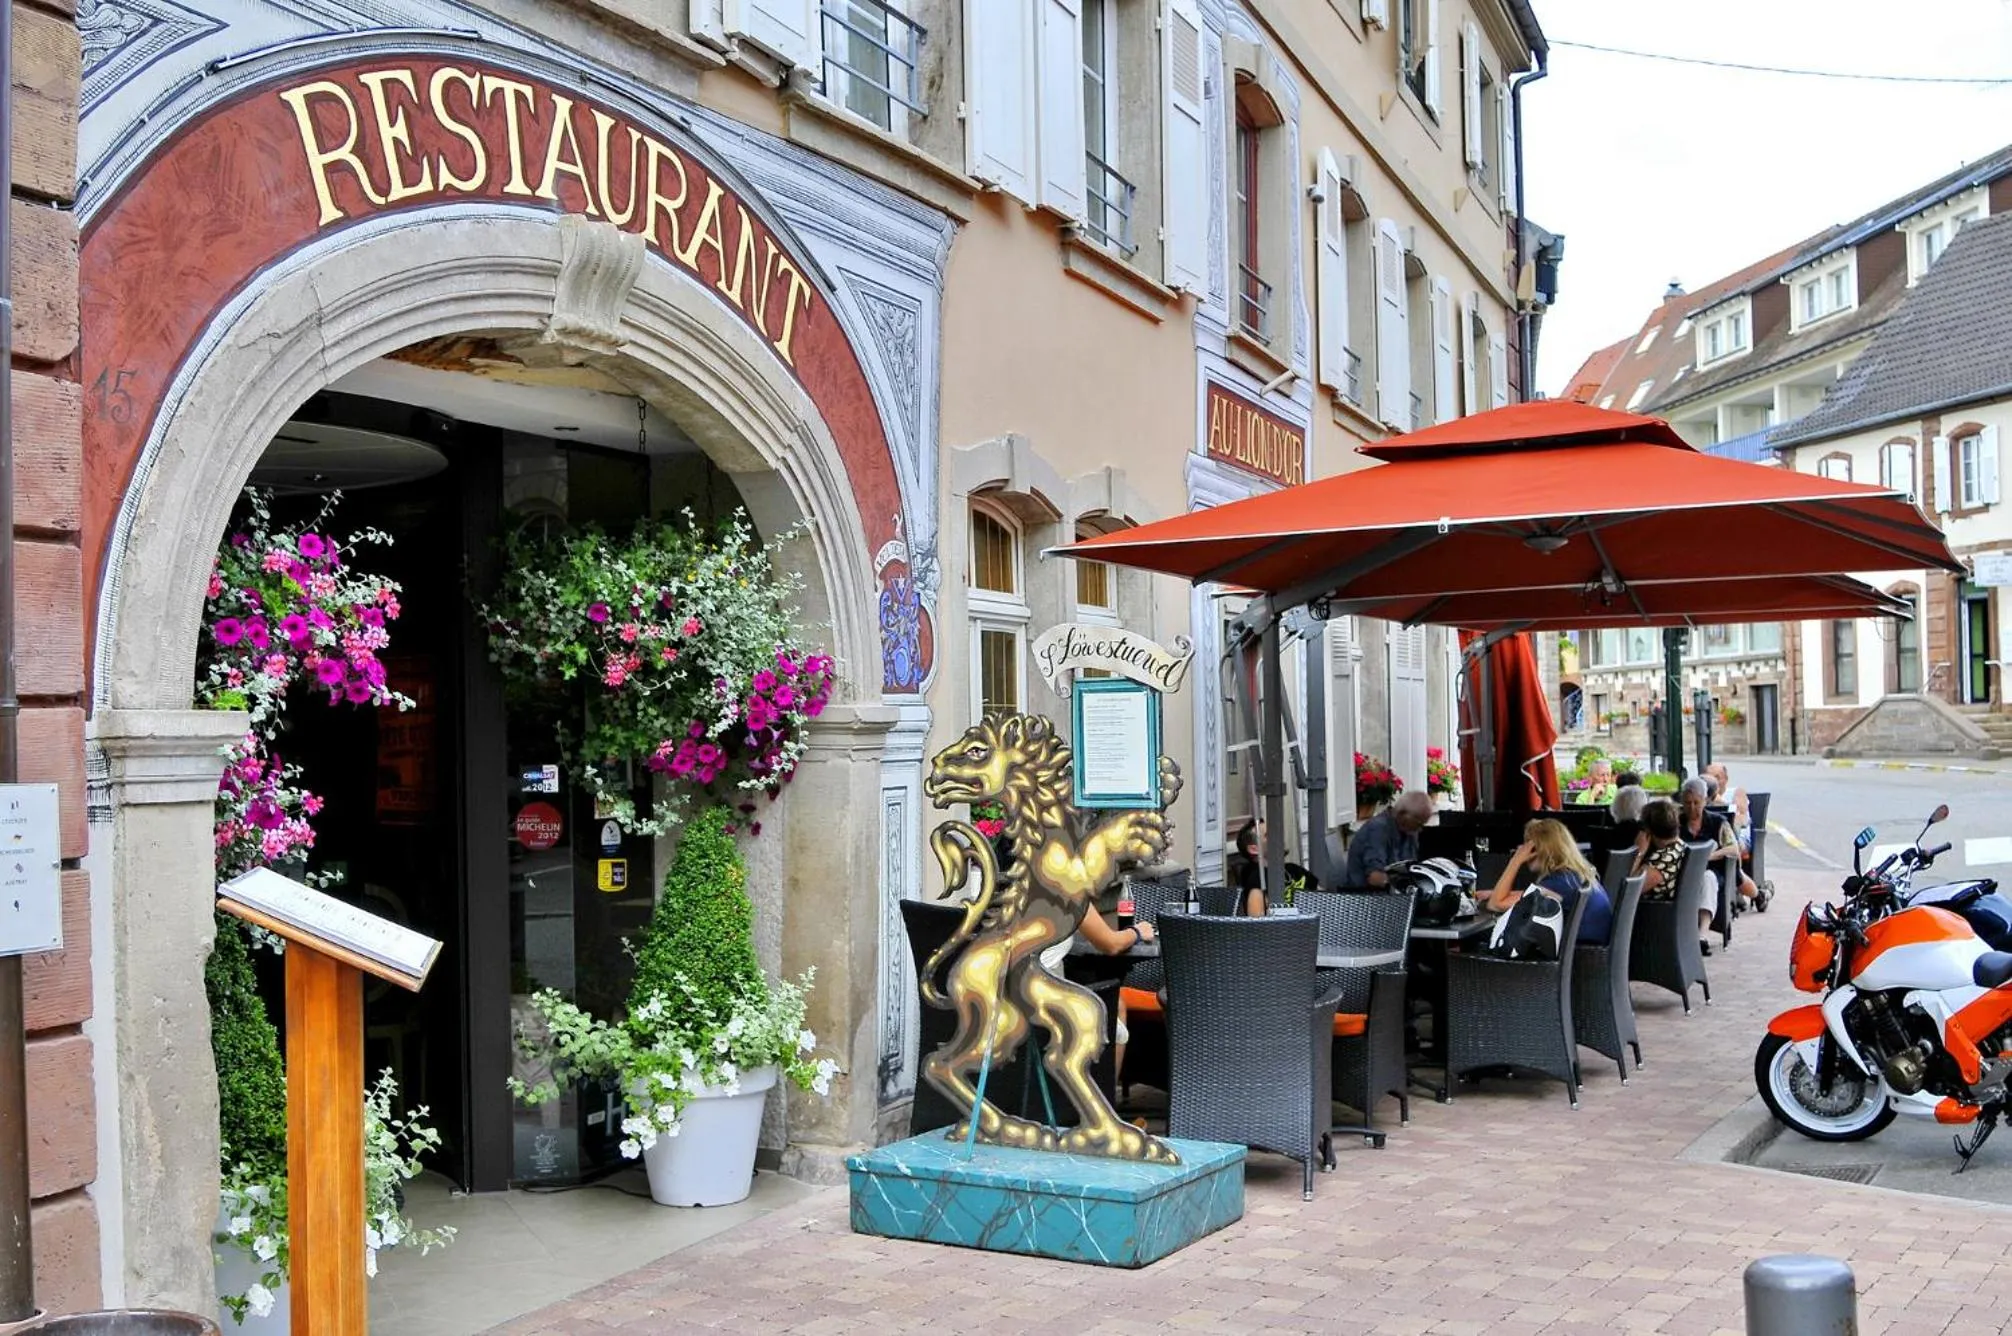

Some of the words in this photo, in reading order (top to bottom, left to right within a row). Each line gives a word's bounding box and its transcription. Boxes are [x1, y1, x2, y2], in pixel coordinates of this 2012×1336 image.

[280, 66, 811, 367] RESTAURANT
[90, 367, 138, 423] 15
[532, 783, 552, 791] 2012
[517, 823, 560, 832] MICHELIN
